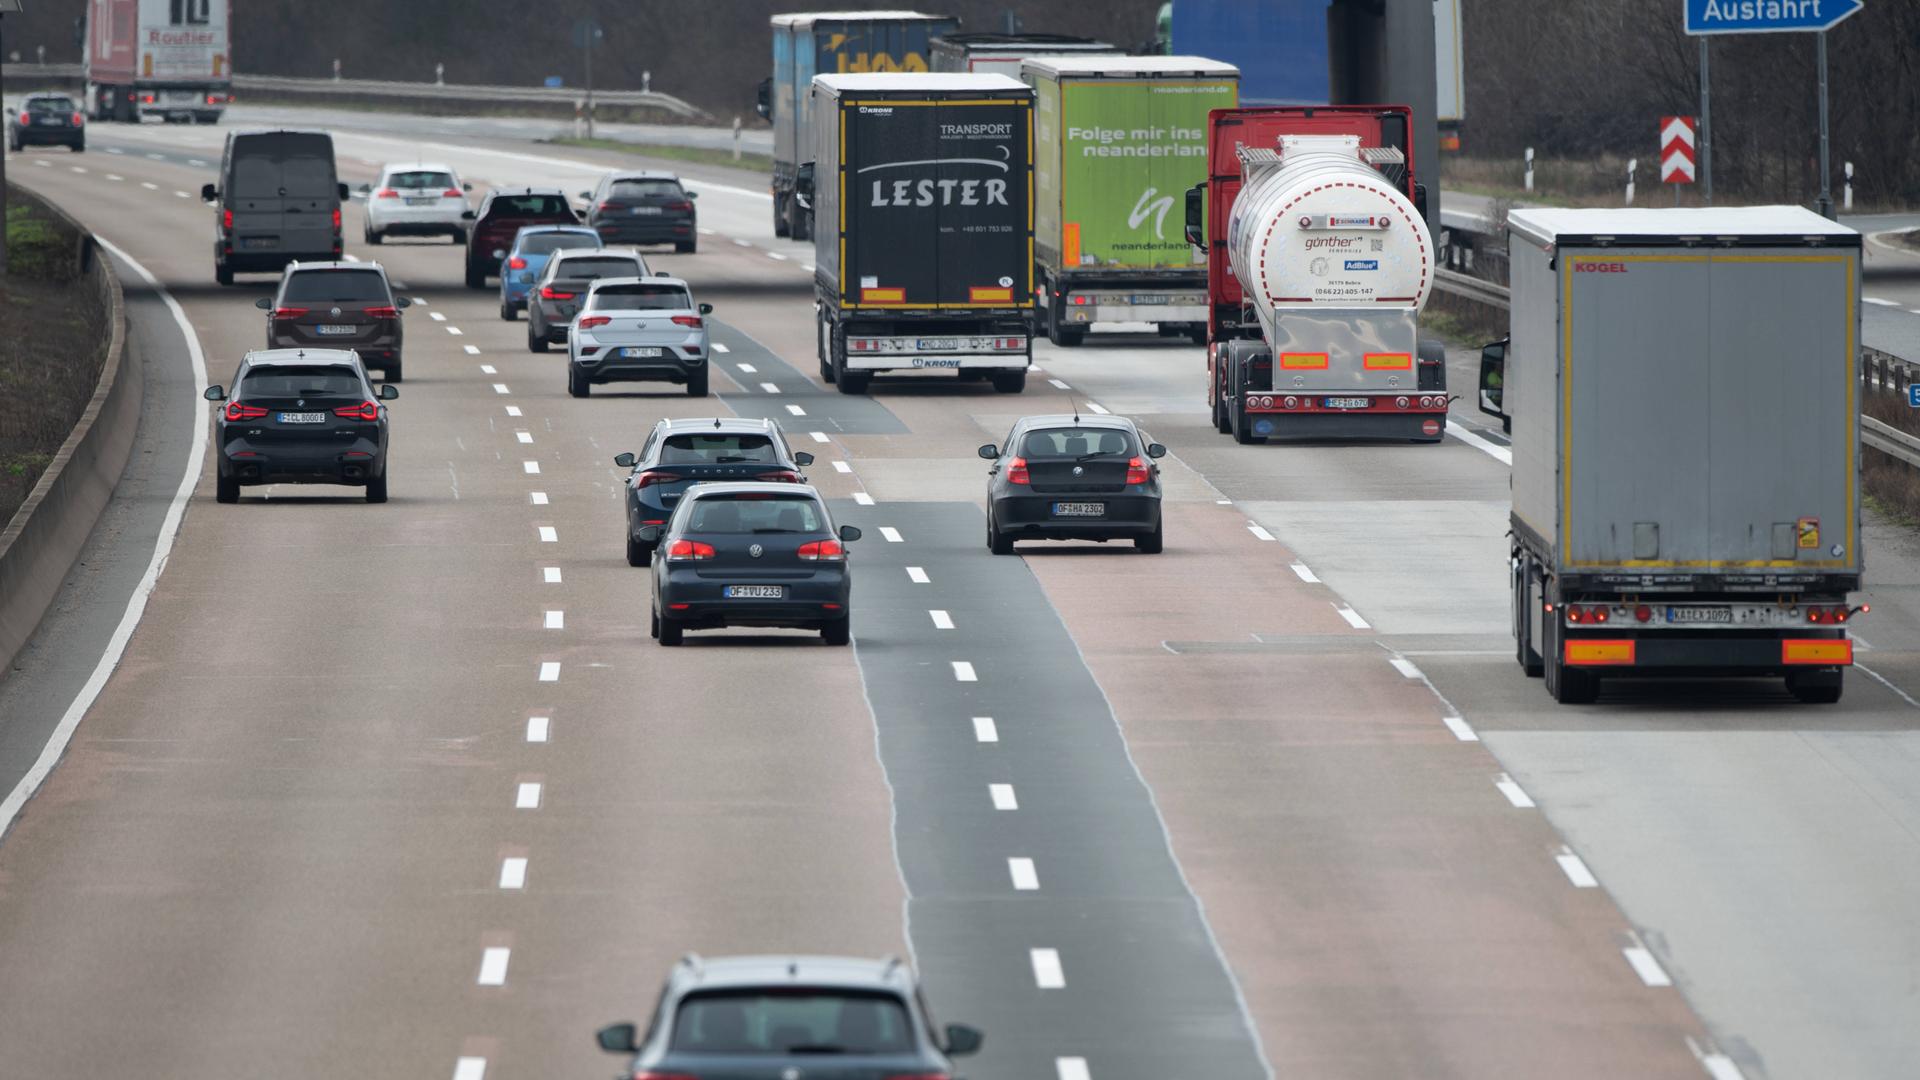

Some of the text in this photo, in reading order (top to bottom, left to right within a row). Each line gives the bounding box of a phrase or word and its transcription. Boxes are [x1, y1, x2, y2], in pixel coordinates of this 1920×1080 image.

[1703, 0, 1821, 21] Ausfahrt
[150, 30, 215, 45] Routier
[1154, 86, 1229, 94] neanderland.de
[940, 124, 1012, 134] TRANSPORT
[1068, 126, 1203, 143] Folge mir ins
[1083, 144, 1209, 157] neanderlan
[871, 178, 1009, 207] LESTER
[1112, 241, 1191, 250] neanderland
[1305, 236, 1353, 251] günther
[924, 359, 961, 367] KRONE
[763, 586, 781, 596] 233
